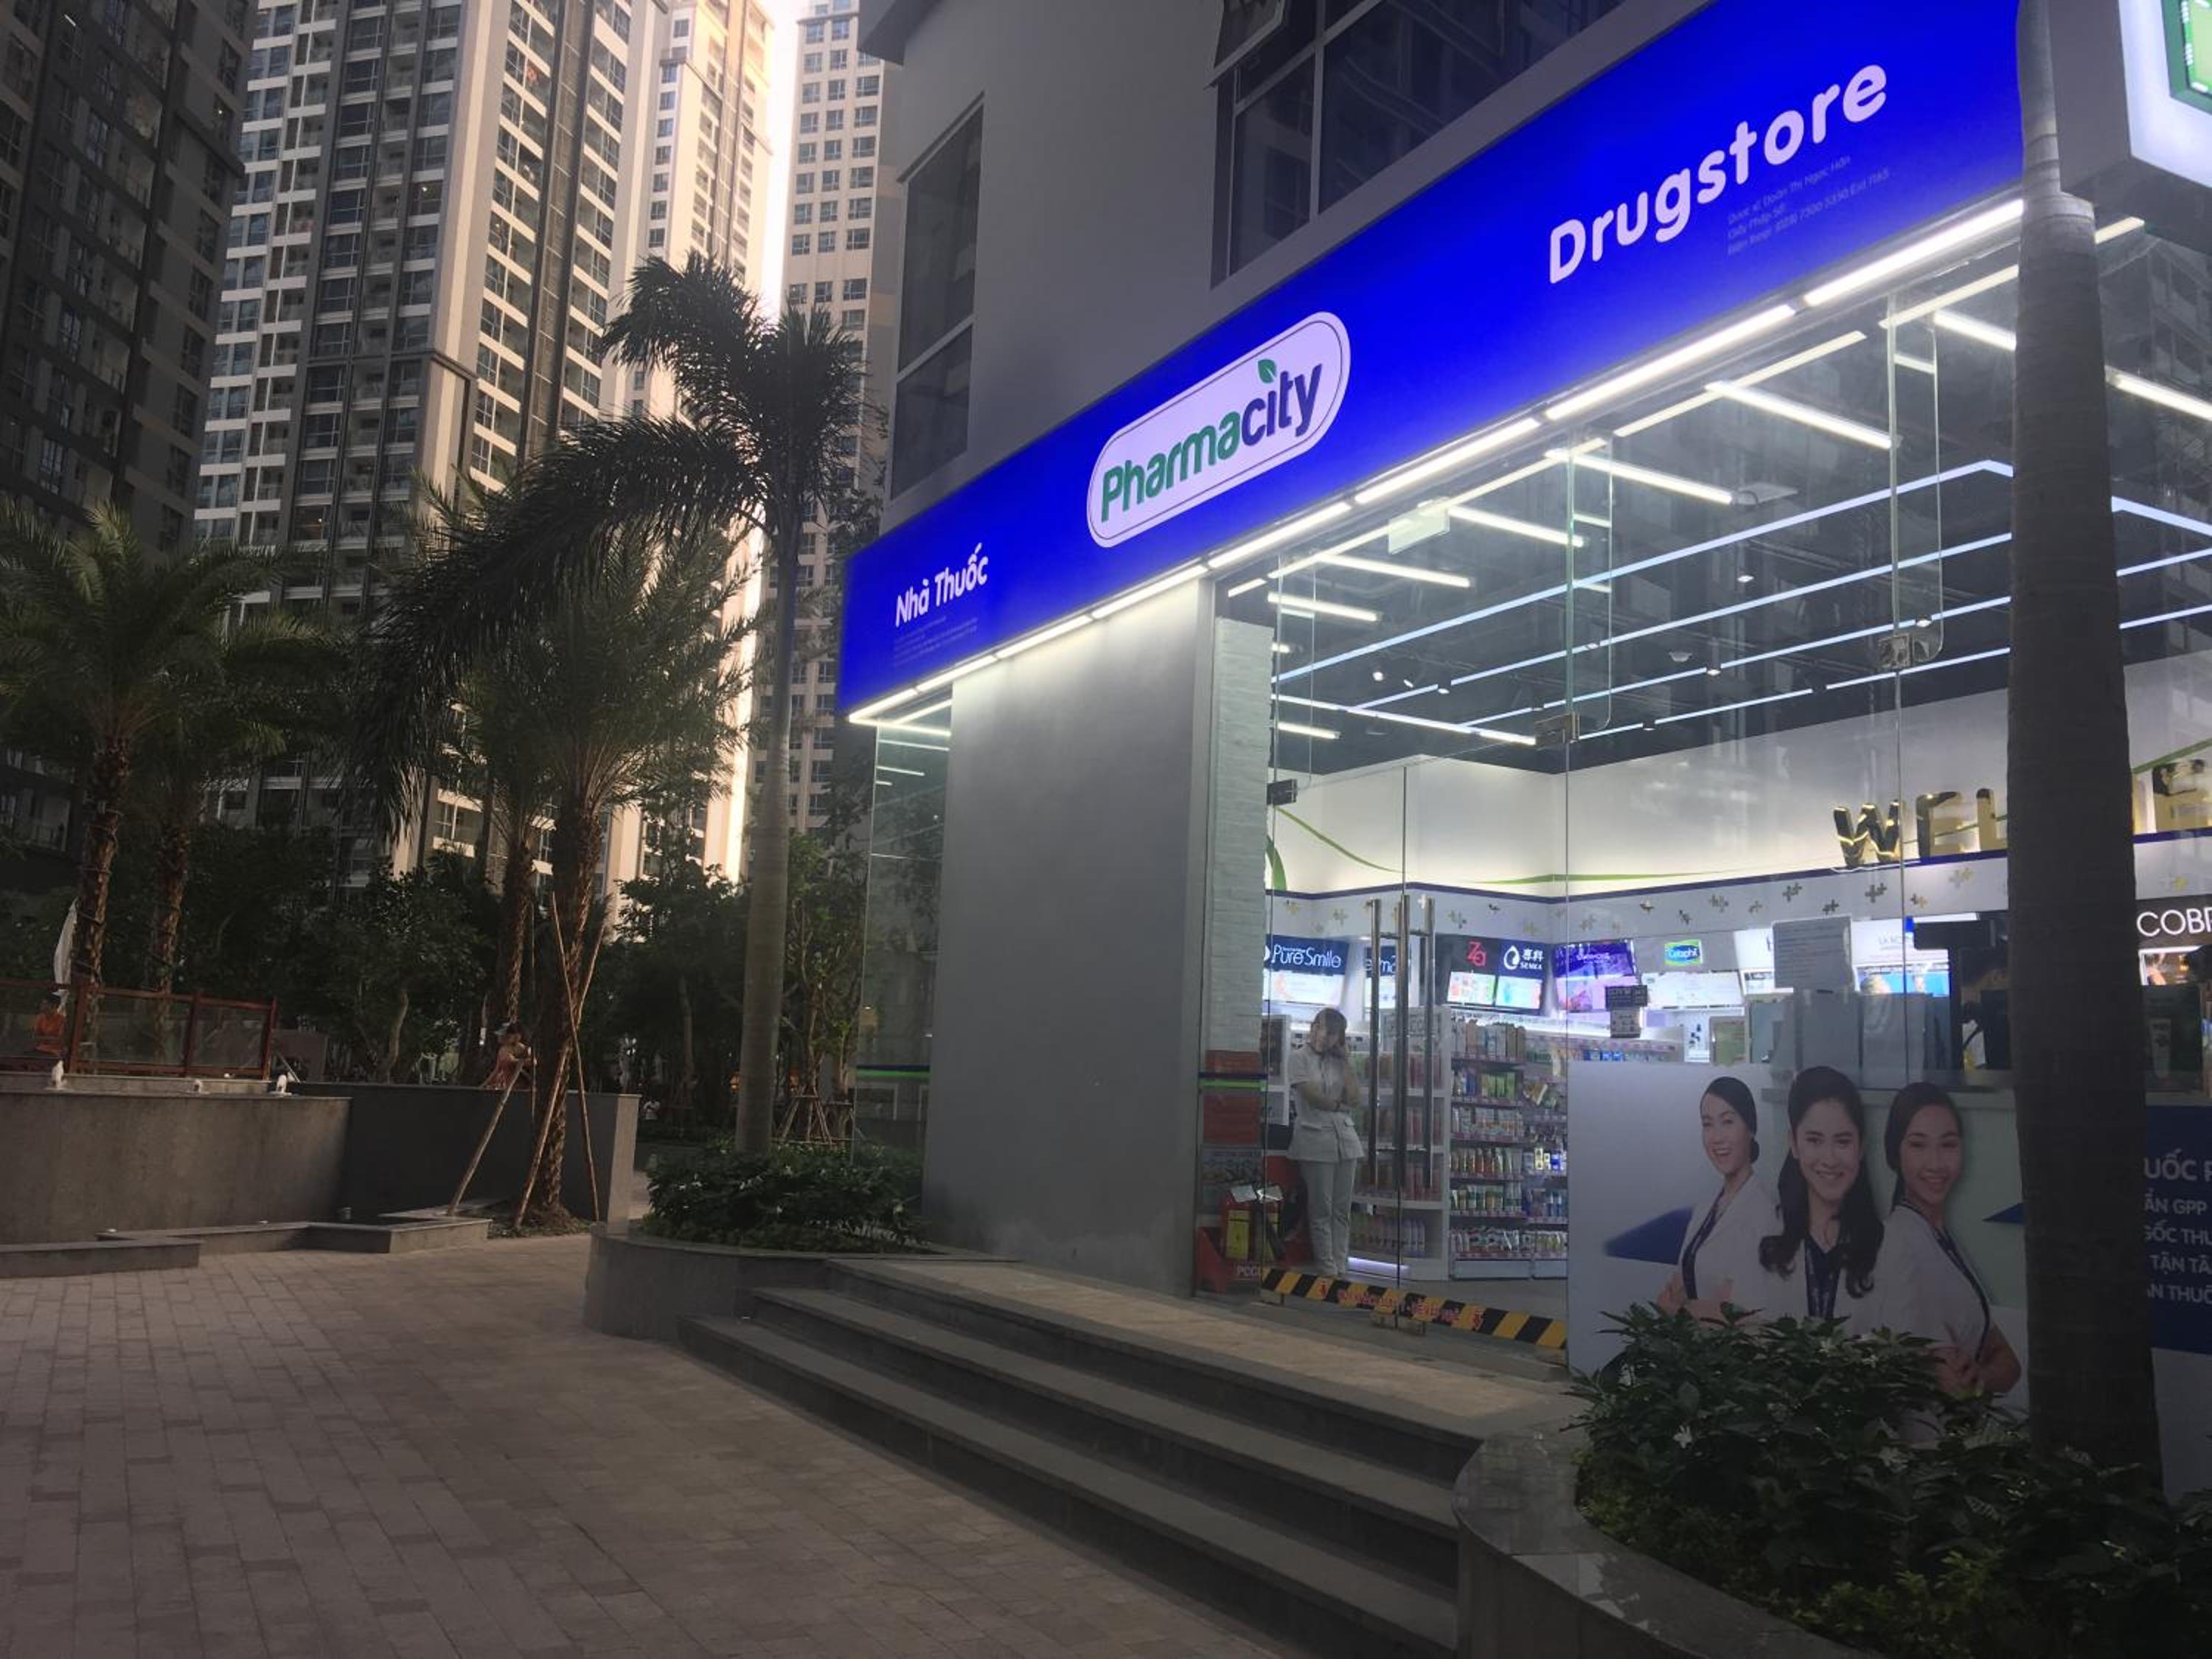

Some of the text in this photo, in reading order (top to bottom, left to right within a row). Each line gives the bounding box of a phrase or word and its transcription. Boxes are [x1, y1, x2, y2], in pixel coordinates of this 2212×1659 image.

[1550, 64, 1888, 283] Drugstore
[1102, 359, 1322, 522] Pharmacity
[896, 543, 989, 627] Nhà Thuốc
[1834, 788, 2007, 866] WEL
[2143, 1148, 2197, 1181] UỐC
[2172, 1198, 2207, 1216] GPP
[2149, 1251, 2212, 1275] TẬN TÂ
